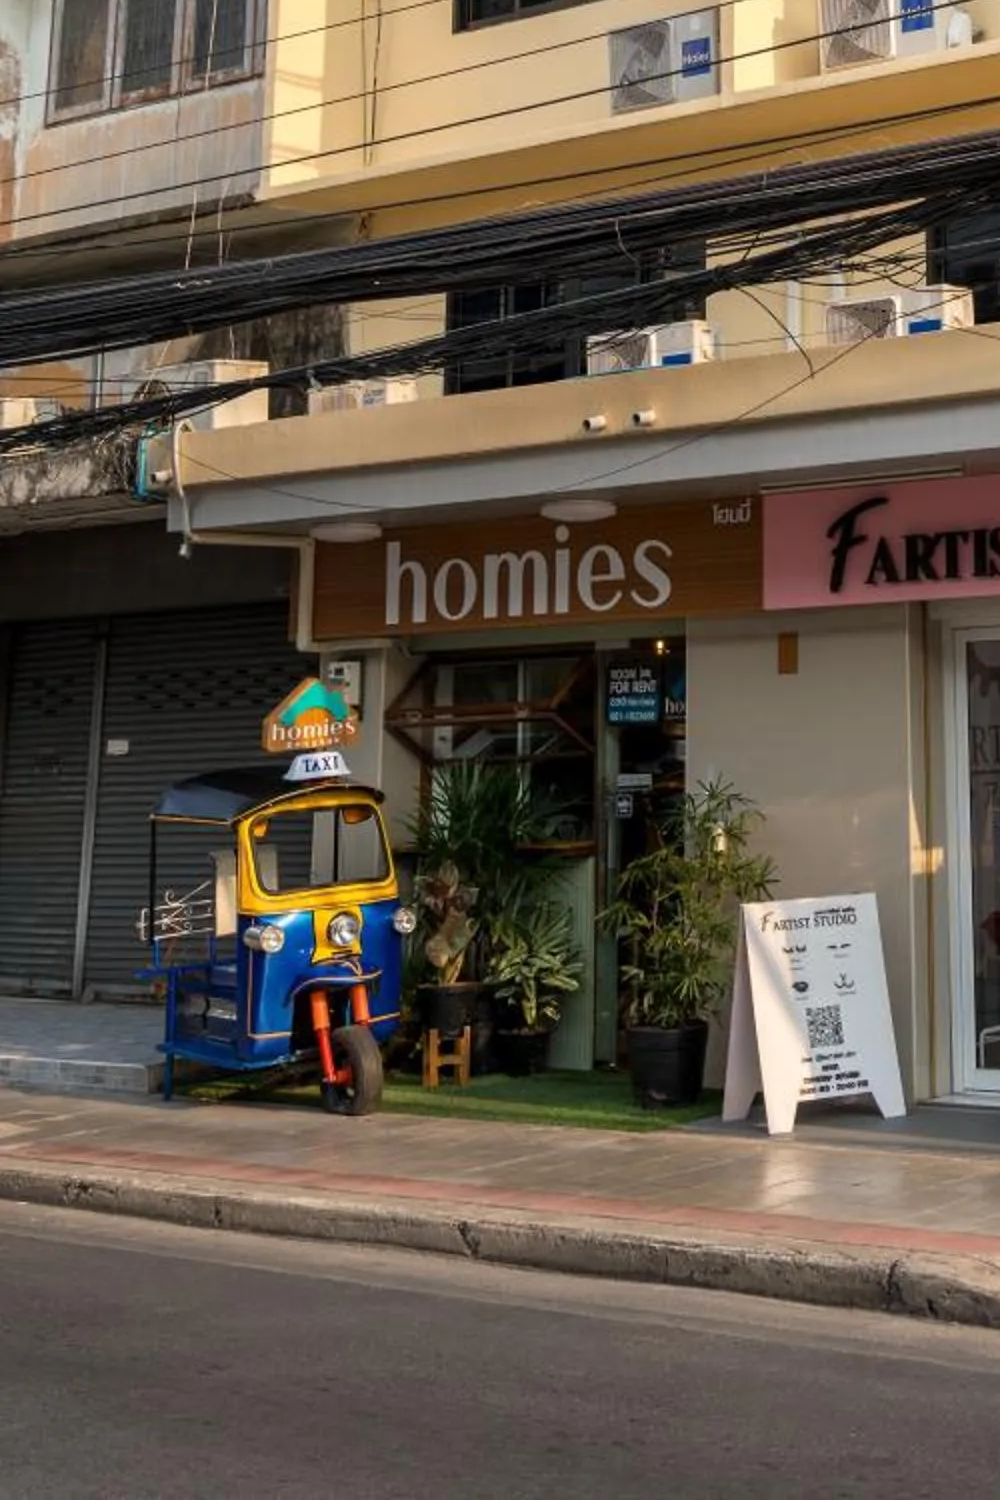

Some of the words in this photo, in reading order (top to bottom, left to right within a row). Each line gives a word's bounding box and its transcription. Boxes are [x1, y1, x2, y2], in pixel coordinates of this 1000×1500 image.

[385, 524, 673, 625] homies
[271, 718, 356, 741] homies
[302, 755, 340, 773] TAXI
[774, 917, 811, 932] ARTIST
[813, 913, 857, 928] STUDIO
